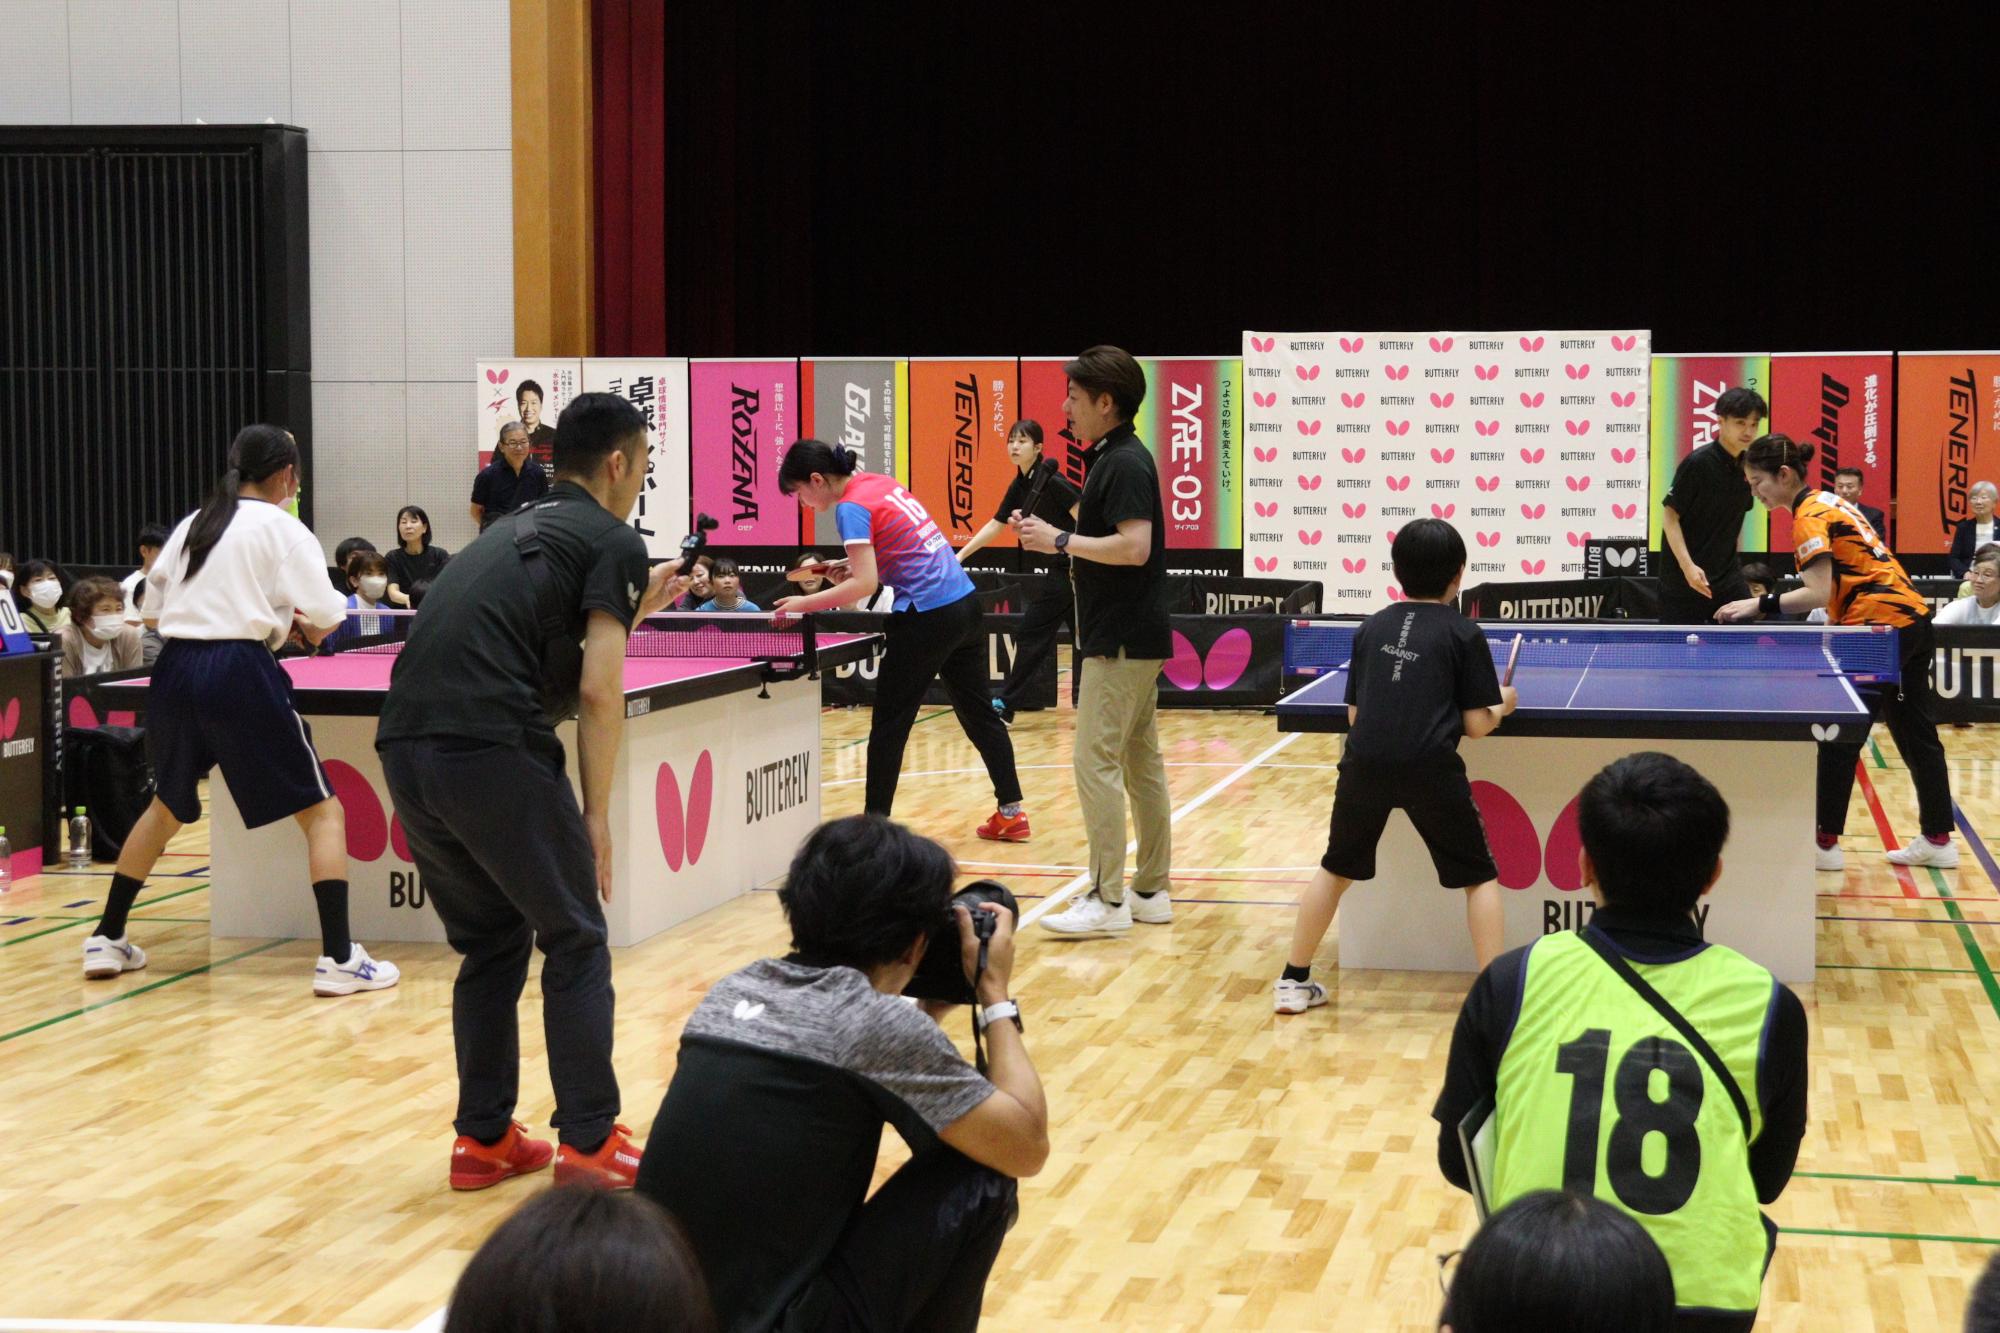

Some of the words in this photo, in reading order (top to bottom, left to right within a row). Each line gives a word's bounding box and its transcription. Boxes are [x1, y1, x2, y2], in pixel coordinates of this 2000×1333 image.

[1290, 341, 1325, 351] BUTTERFLY
[1379, 340, 1414, 351] BUTTERFLY
[1469, 340, 1504, 351] BUTTERFLY
[1560, 339, 1596, 350] BUTTERFLY
[1248, 367, 1281, 378] BUTTERFLY
[1335, 368, 1370, 378] BUTTERFLY
[1424, 368, 1460, 378] BUTTERFLY
[1514, 367, 1550, 378] BUTTERFLY
[1605, 367, 1641, 377] BUTTERFLY
[1291, 396, 1326, 406] BUTTERFLY
[1380, 396, 1415, 406] BUTTERFLY
[1469, 396, 1505, 406] BUTTERFLY
[1560, 395, 1596, 406] BUTTERFLY
[993, 379, 1005, 438] 勝つために。
[1863, 374, 1878, 468] 進化が圧倒する。
[1249, 422, 1283, 433] BUTTERFLY
[1336, 423, 1371, 434] BUTTERFLY
[1425, 423, 1460, 434] BUTTERFLY
[1514, 423, 1550, 434] BUTTERFLY
[1605, 423, 1641, 433] BUTTERFLY
[1221, 380, 1232, 493] つよさの形を変えていけ。
[731, 382, 759, 524] ROZENA
[947, 373, 980, 533] TENERGY
[1171, 382, 1203, 521] ZYRE-03
[1292, 450, 1327, 461] BUTTERFLY
[1380, 451, 1416, 461] BUTTERFLY
[1470, 451, 1505, 462] BUTTERFLY
[1560, 451, 1596, 461] BUTTERFLY
[1249, 477, 1283, 488] BUTTERFLY
[1336, 479, 1371, 489] BUTTERFLY
[1425, 479, 1460, 489] BUTTERFLY
[1515, 479, 1551, 489] BUTTERFLY
[1605, 479, 1642, 489] BUTTERFLY
[1293, 505, 1327, 516] BUTTERFLY
[1381, 506, 1416, 517] BUTTERFLY
[1470, 507, 1506, 517] BUTTERFLY
[1561, 507, 1597, 517] BUTTERFLY
[1249, 532, 1284, 543] BUTTERFLY
[1337, 534, 1372, 544] BUTTERFLY
[1516, 535, 1551, 545] BUTTERFLY
[1293, 560, 1327, 571] BUTTERFLY
[1470, 562, 1506, 573] BUTTERFLY
[1561, 563, 1585, 572] BUTTER
[1337, 588, 1372, 599] BUTTERFLY
[1398, 612, 1415, 648] RUNNING
[1380, 644, 1420, 662] AGAINST
[3, 737, 35, 758] BUTTERFLY
[746, 750, 810, 825] BUTTERFLY
[1555, 1027, 1704, 1216] 18
